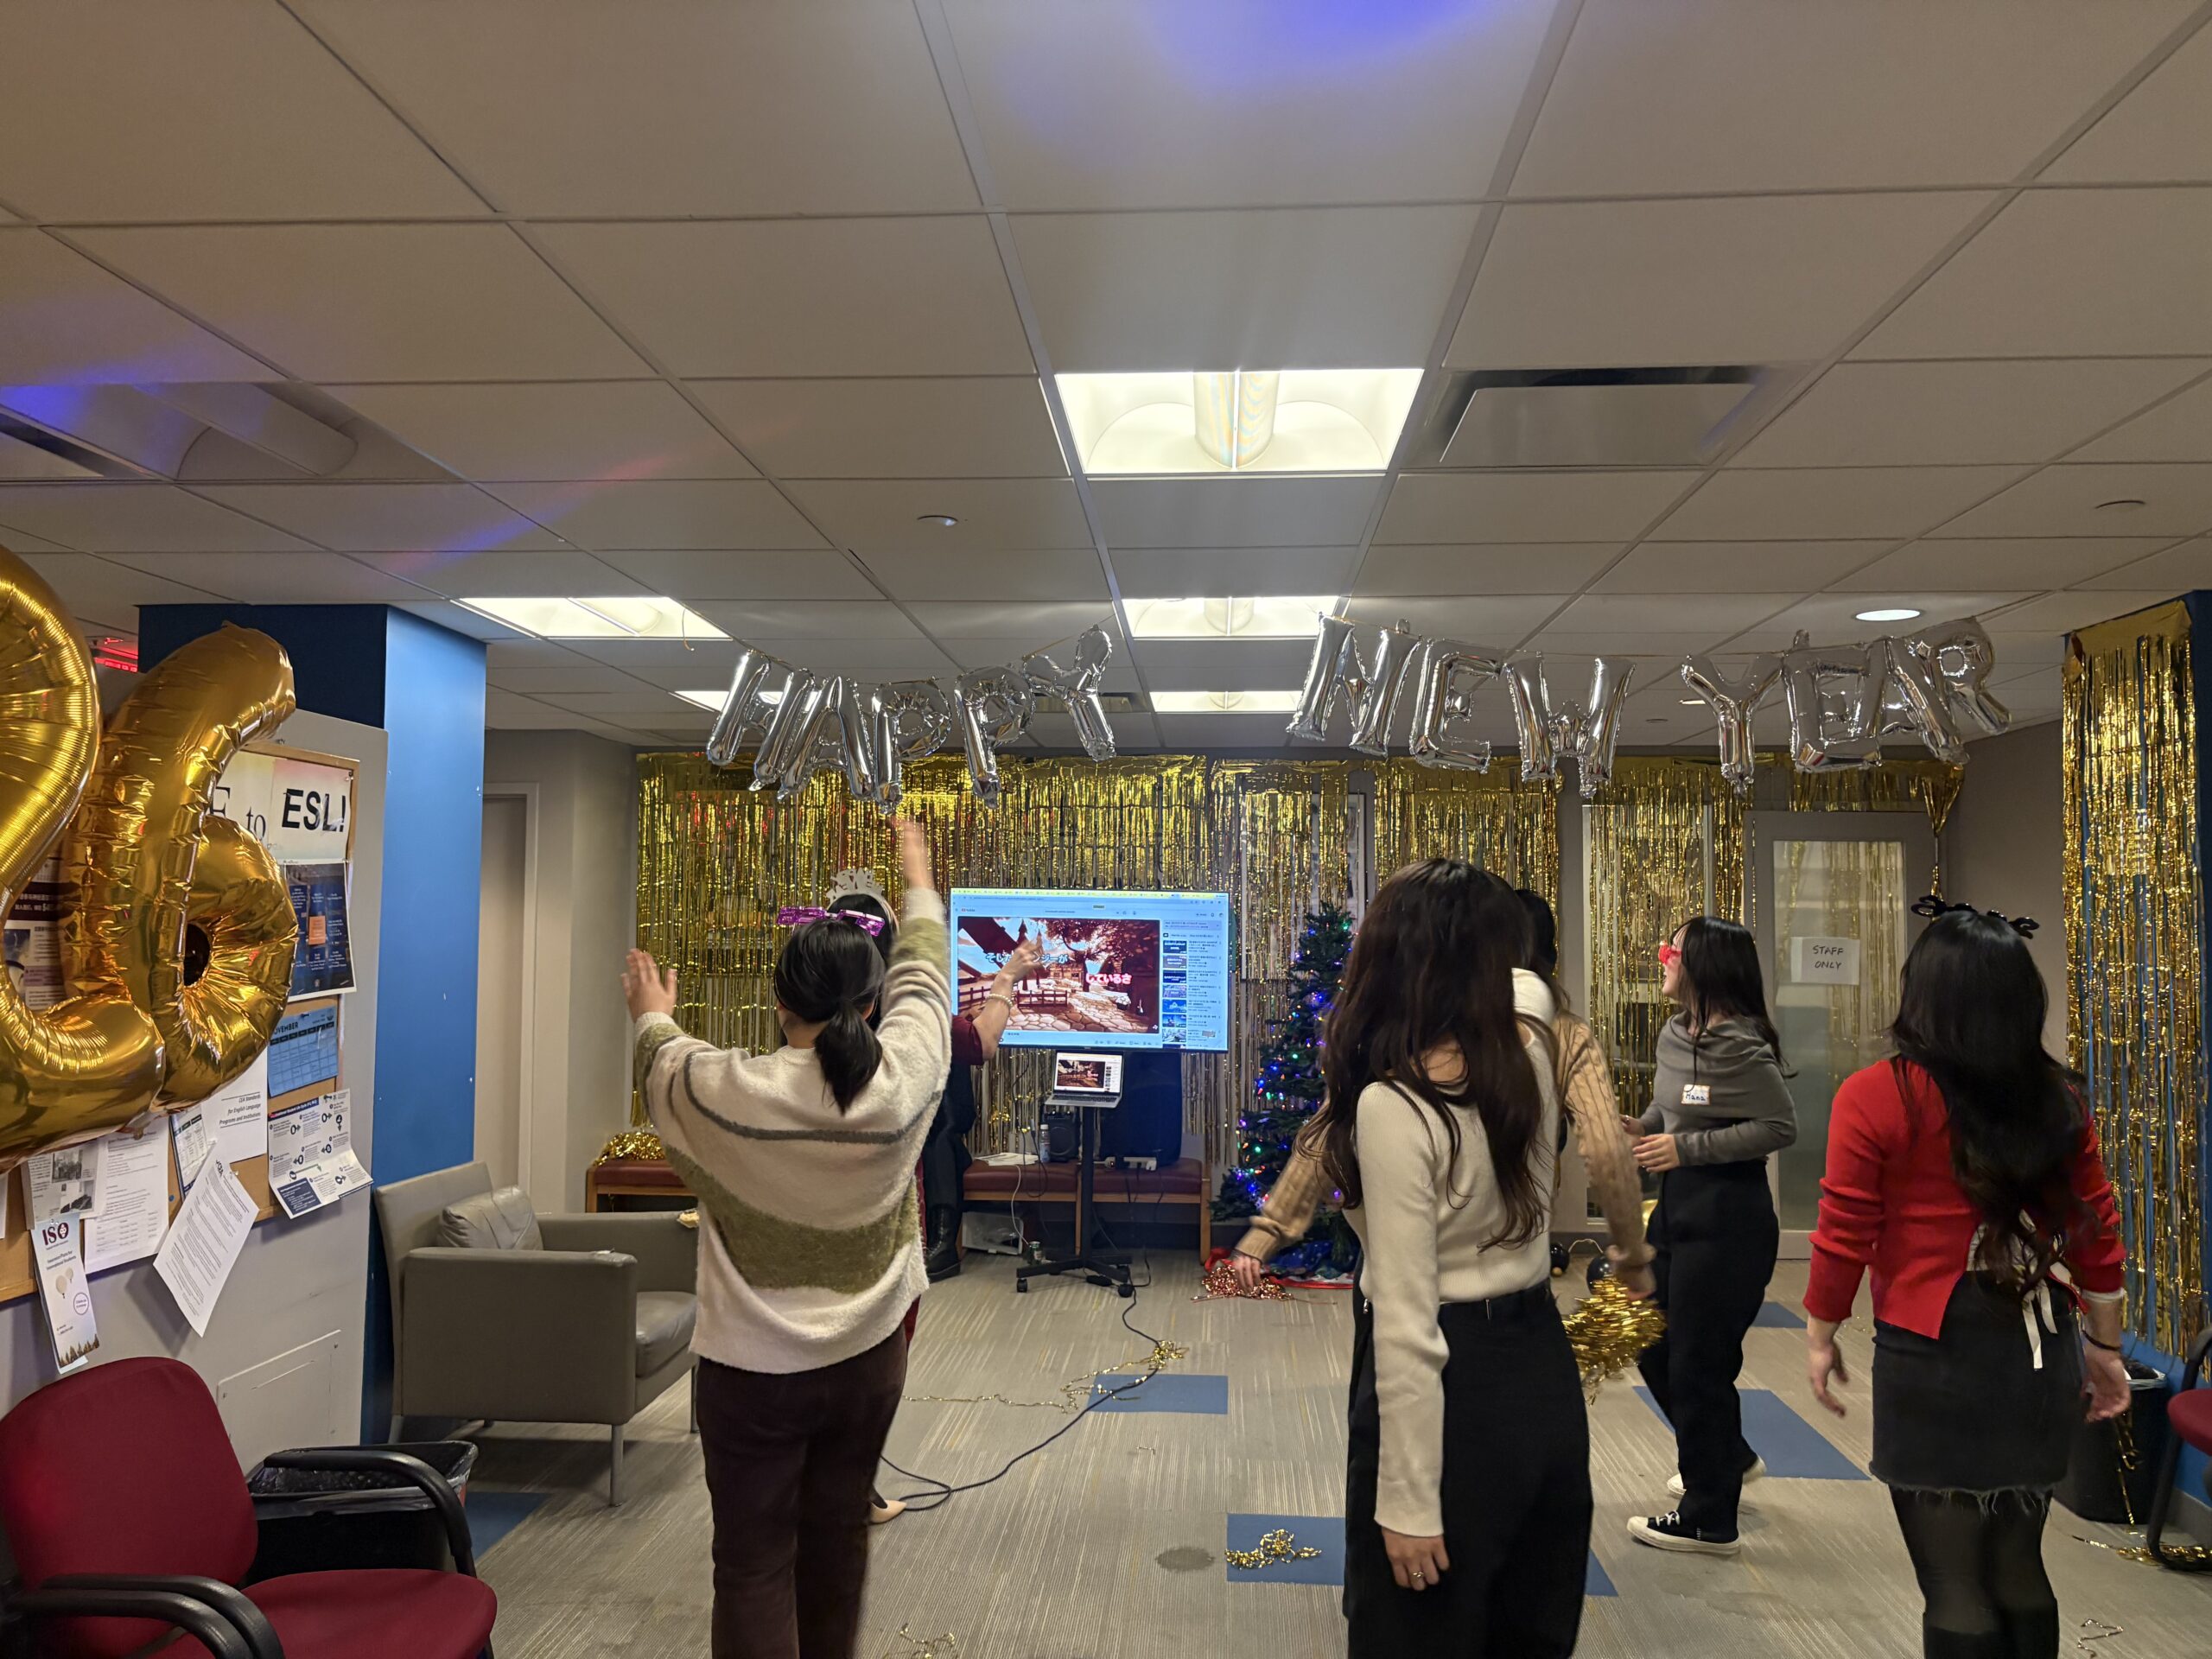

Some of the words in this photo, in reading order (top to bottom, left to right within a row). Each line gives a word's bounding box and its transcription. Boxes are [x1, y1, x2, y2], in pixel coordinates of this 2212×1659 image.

[707, 624, 1116, 815] HAPPY
[1286, 611, 1637, 798] NEW
[1680, 616, 2012, 795] YEAR
[246, 806, 266, 842] to
[282, 788, 346, 833] ESL!
[1812, 944, 1844, 956] STAFF
[1815, 960, 1842, 970] ONLY
[41, 1222, 69, 1246] ISO
